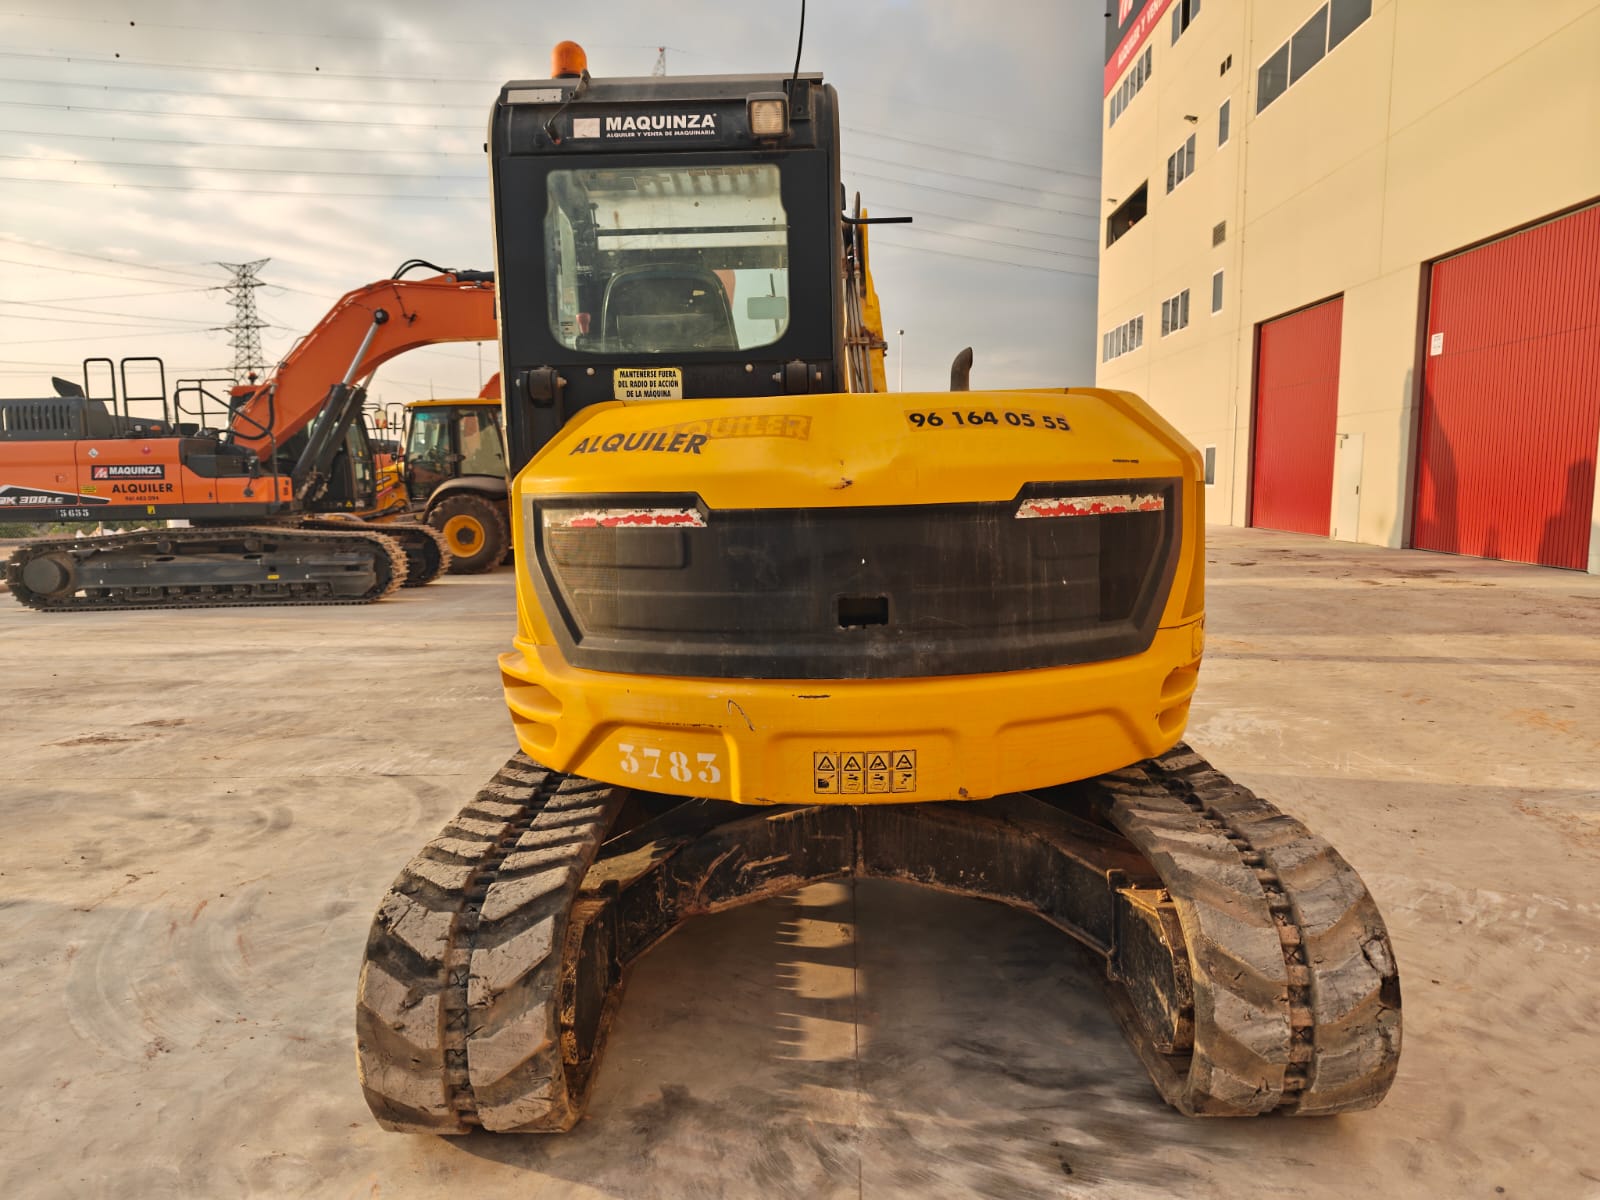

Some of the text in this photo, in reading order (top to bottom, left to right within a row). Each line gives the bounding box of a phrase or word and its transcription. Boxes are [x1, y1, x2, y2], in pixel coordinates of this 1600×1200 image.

[605, 114, 715, 131] MAQUINZA
[630, 380, 647, 388] RADIO
[659, 378, 678, 388] ACCIÓN
[909, 411, 1071, 431] 96 164 05 55
[569, 432, 708, 456] ALQUILER
[109, 466, 161, 475] MAQUINZA
[112, 483, 173, 493] ALQUILER
[618, 743, 721, 784] 3783
